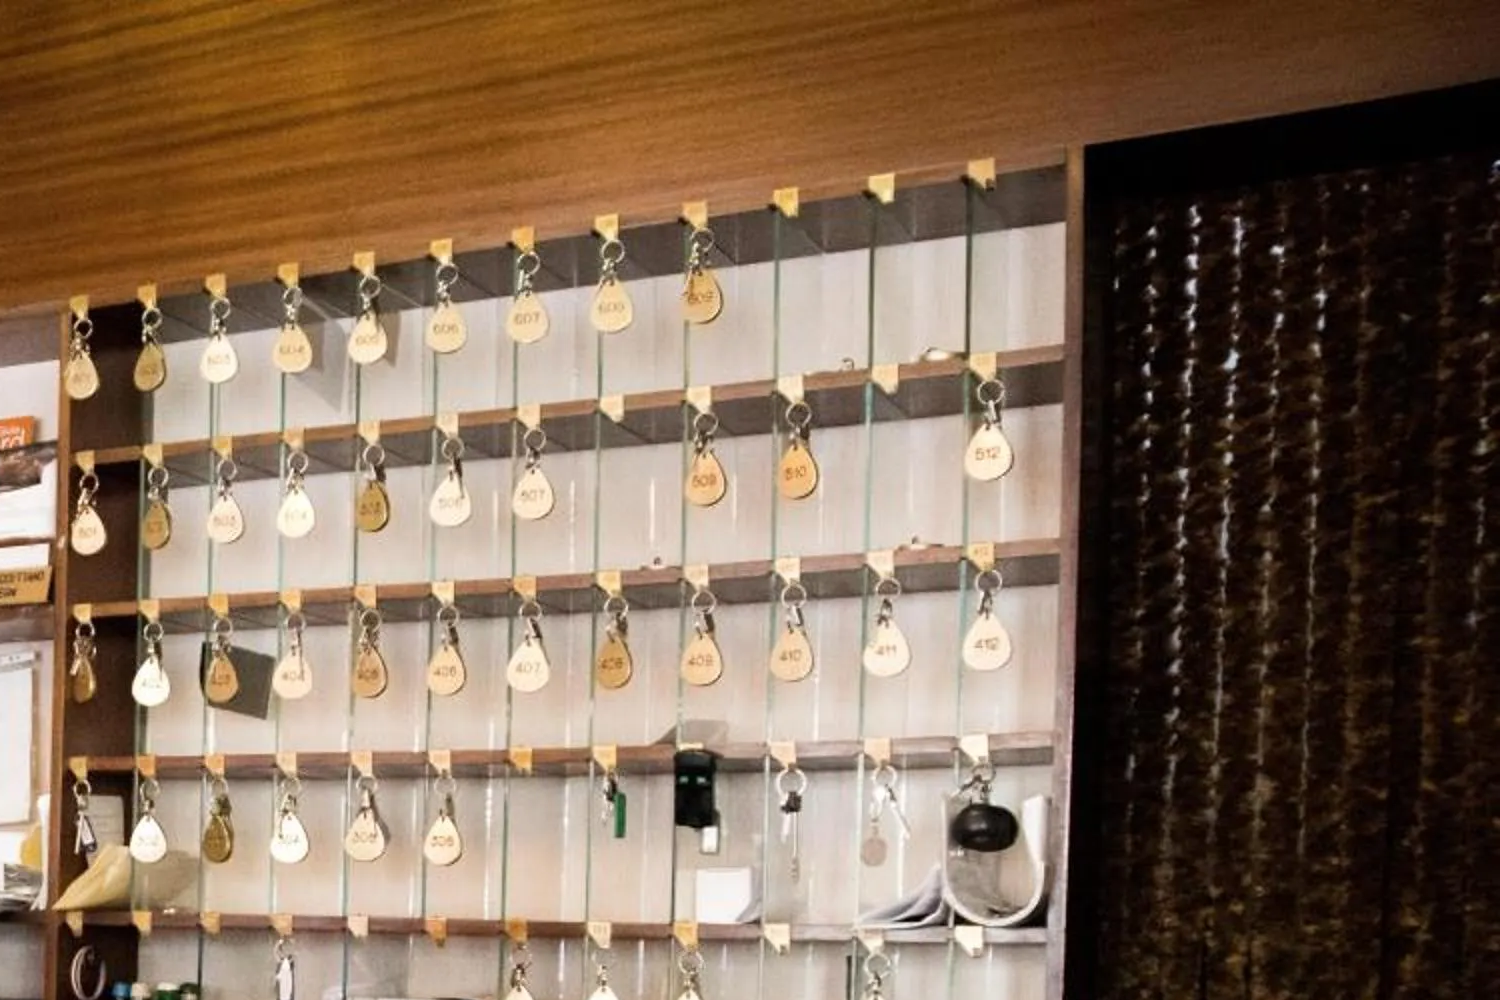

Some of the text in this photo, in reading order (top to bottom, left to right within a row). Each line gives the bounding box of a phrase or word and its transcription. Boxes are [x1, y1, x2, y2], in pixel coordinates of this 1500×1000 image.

[514, 312, 540, 325] 607
[975, 446, 1001, 461] 512
[874, 644, 898, 658] 411
[972, 637, 999, 651] 412
[779, 649, 802, 662] 410
[515, 662, 541, 677] 407
